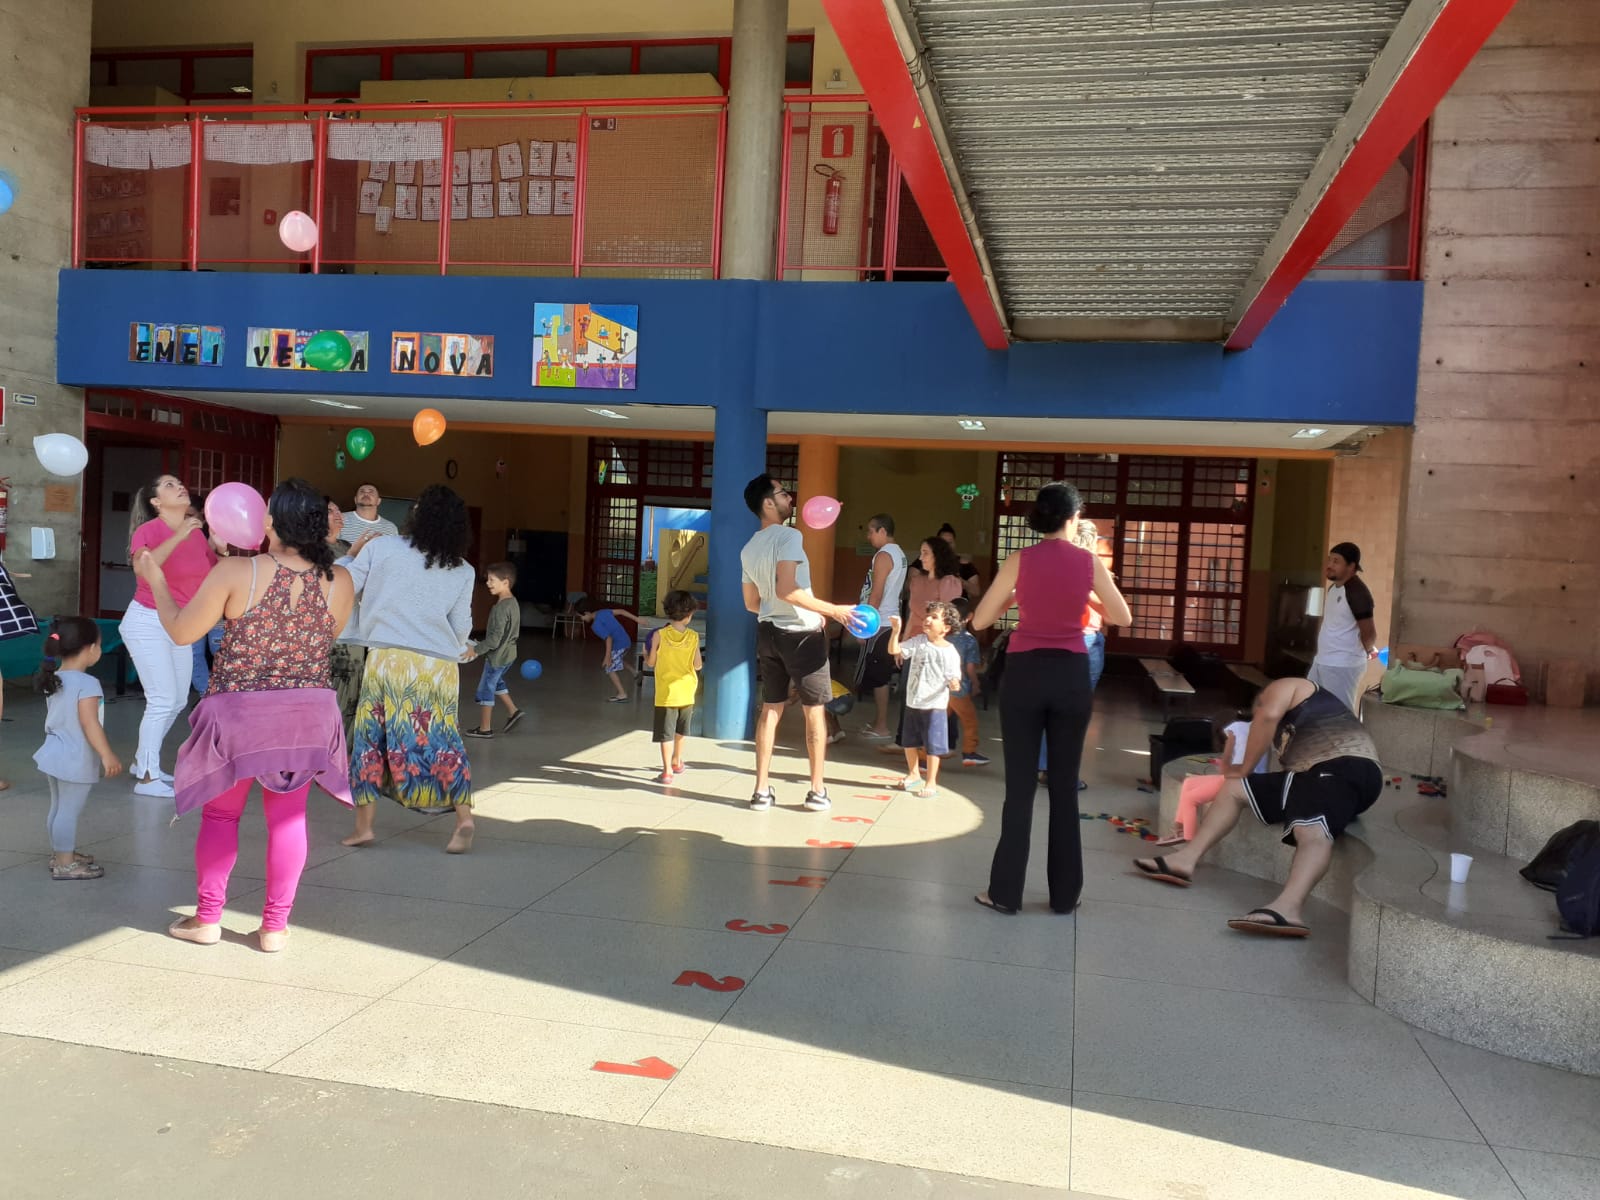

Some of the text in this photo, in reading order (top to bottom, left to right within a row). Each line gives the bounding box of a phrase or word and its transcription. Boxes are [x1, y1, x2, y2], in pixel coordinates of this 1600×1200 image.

[136, 341, 492, 375] EMEI VEA NOVA
[806, 838, 857, 850] 5
[768, 876, 828, 889] 4
[725, 918, 790, 935] 3
[672, 970, 746, 993] 2
[590, 1055, 679, 1081] 1
